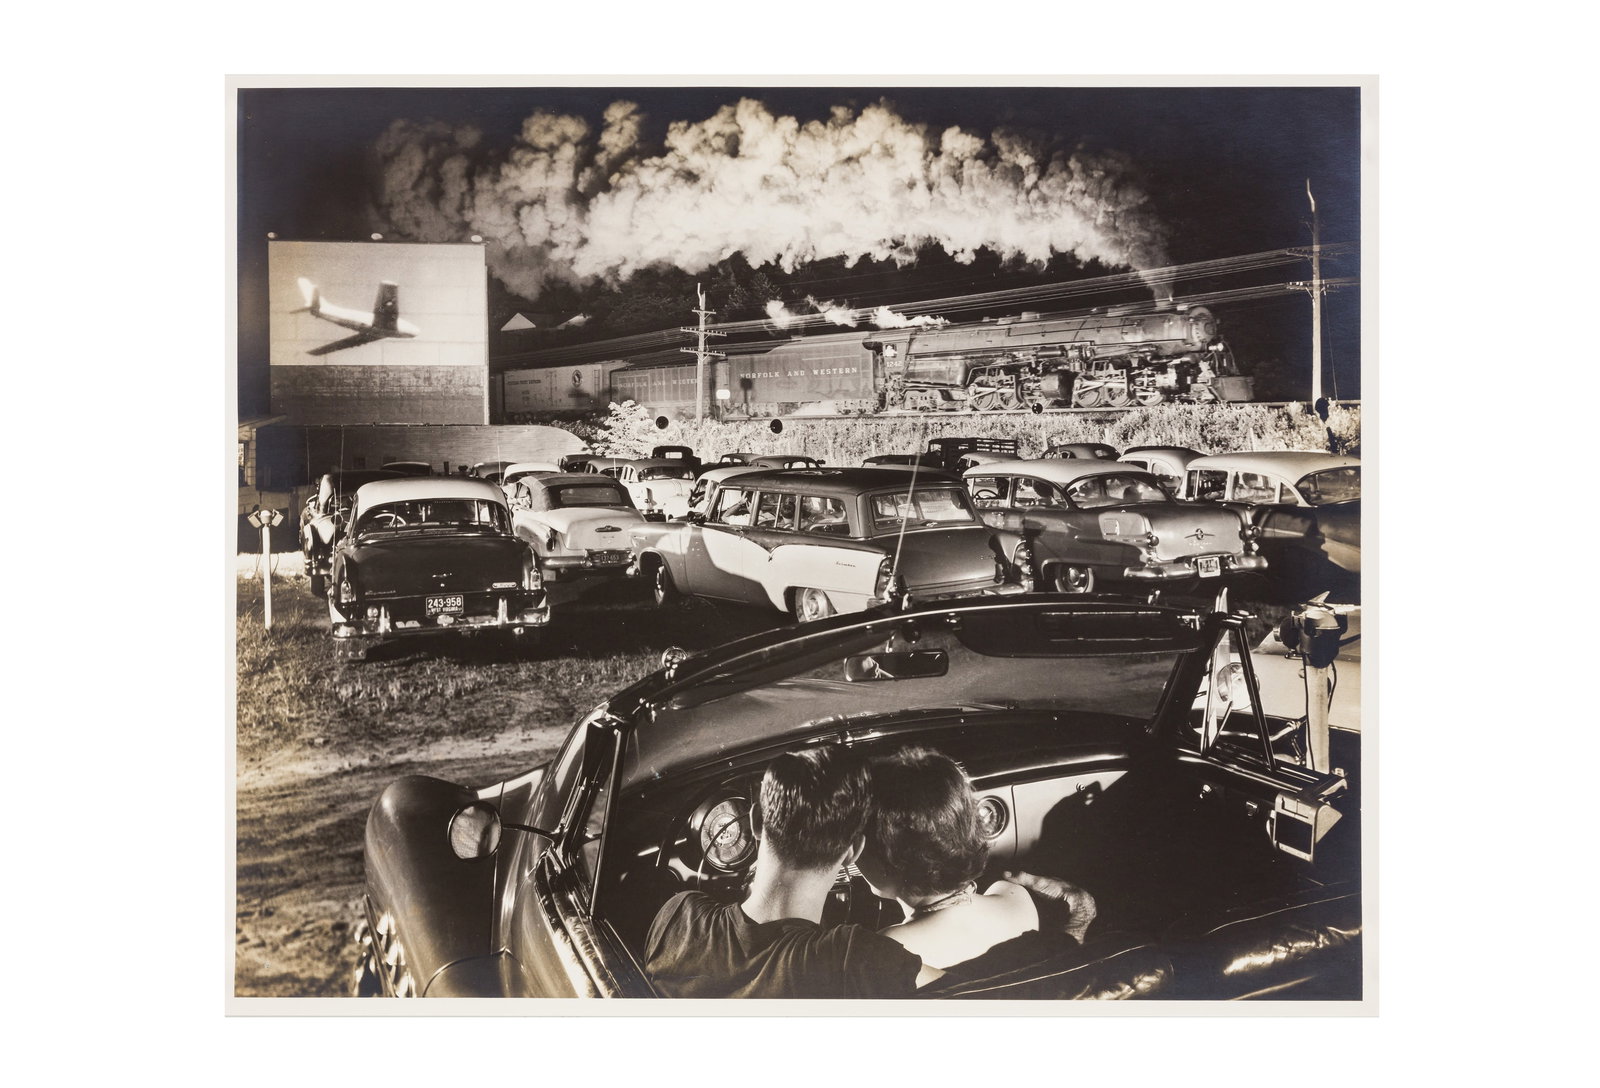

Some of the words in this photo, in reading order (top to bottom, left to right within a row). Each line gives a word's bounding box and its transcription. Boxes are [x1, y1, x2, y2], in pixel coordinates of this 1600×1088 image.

[740, 371, 780, 379] NORFOLK
[812, 367, 858, 376] WESTERN
[427, 597, 462, 609] 243-958
